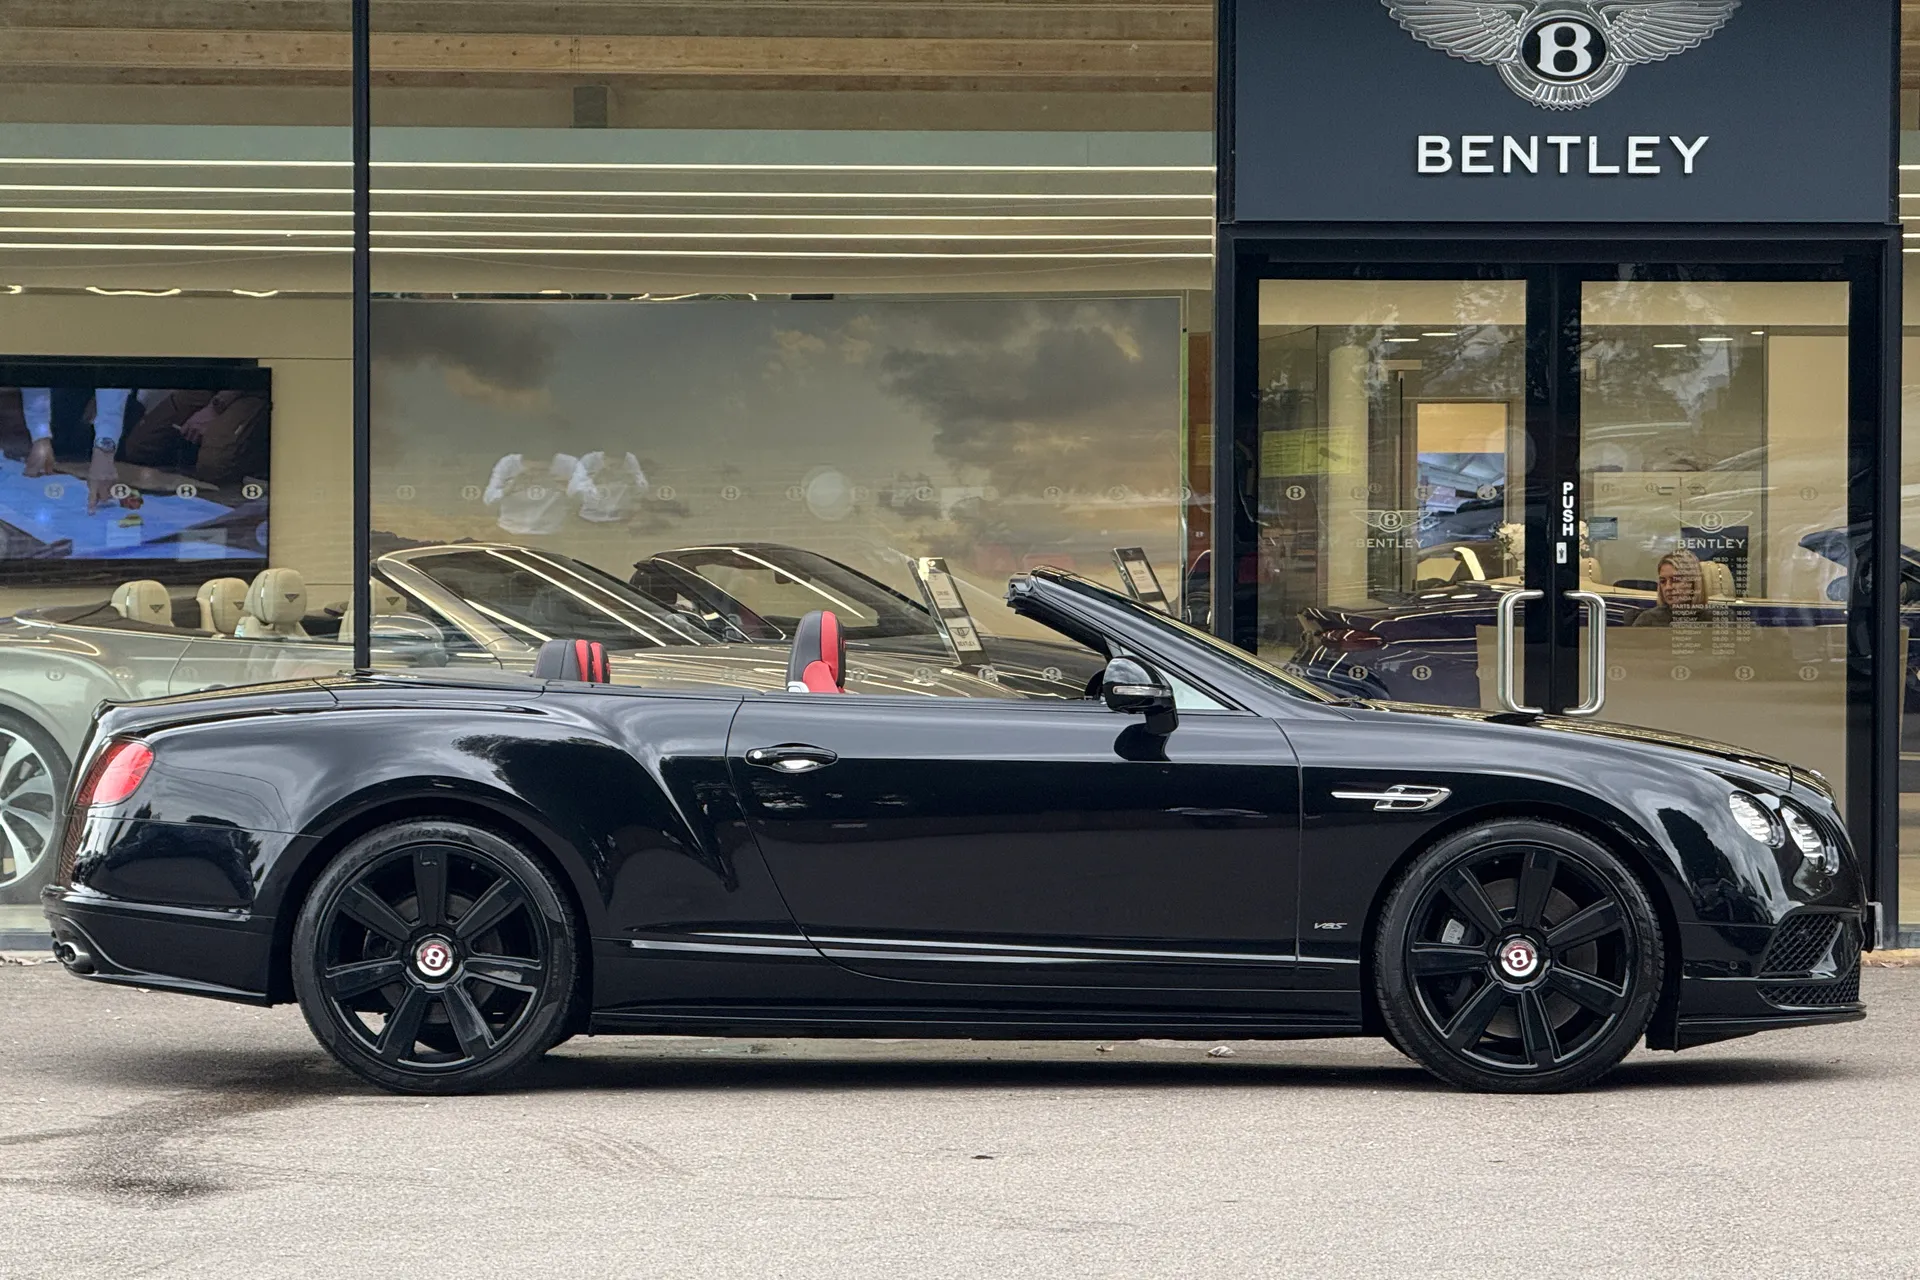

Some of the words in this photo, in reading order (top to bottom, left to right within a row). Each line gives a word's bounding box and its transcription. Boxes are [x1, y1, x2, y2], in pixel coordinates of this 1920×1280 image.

[1536, 20, 1592, 77] B
[1417, 135, 1710, 174] BENTLEY
[1562, 481, 1575, 537] PUSH
[1383, 513, 1398, 527] B
[1703, 513, 1720, 528] B
[1355, 538, 1424, 548] BENTLEY
[1677, 538, 1746, 549] BENTLEY
[424, 947, 446, 968] B
[1508, 948, 1530, 969] B
